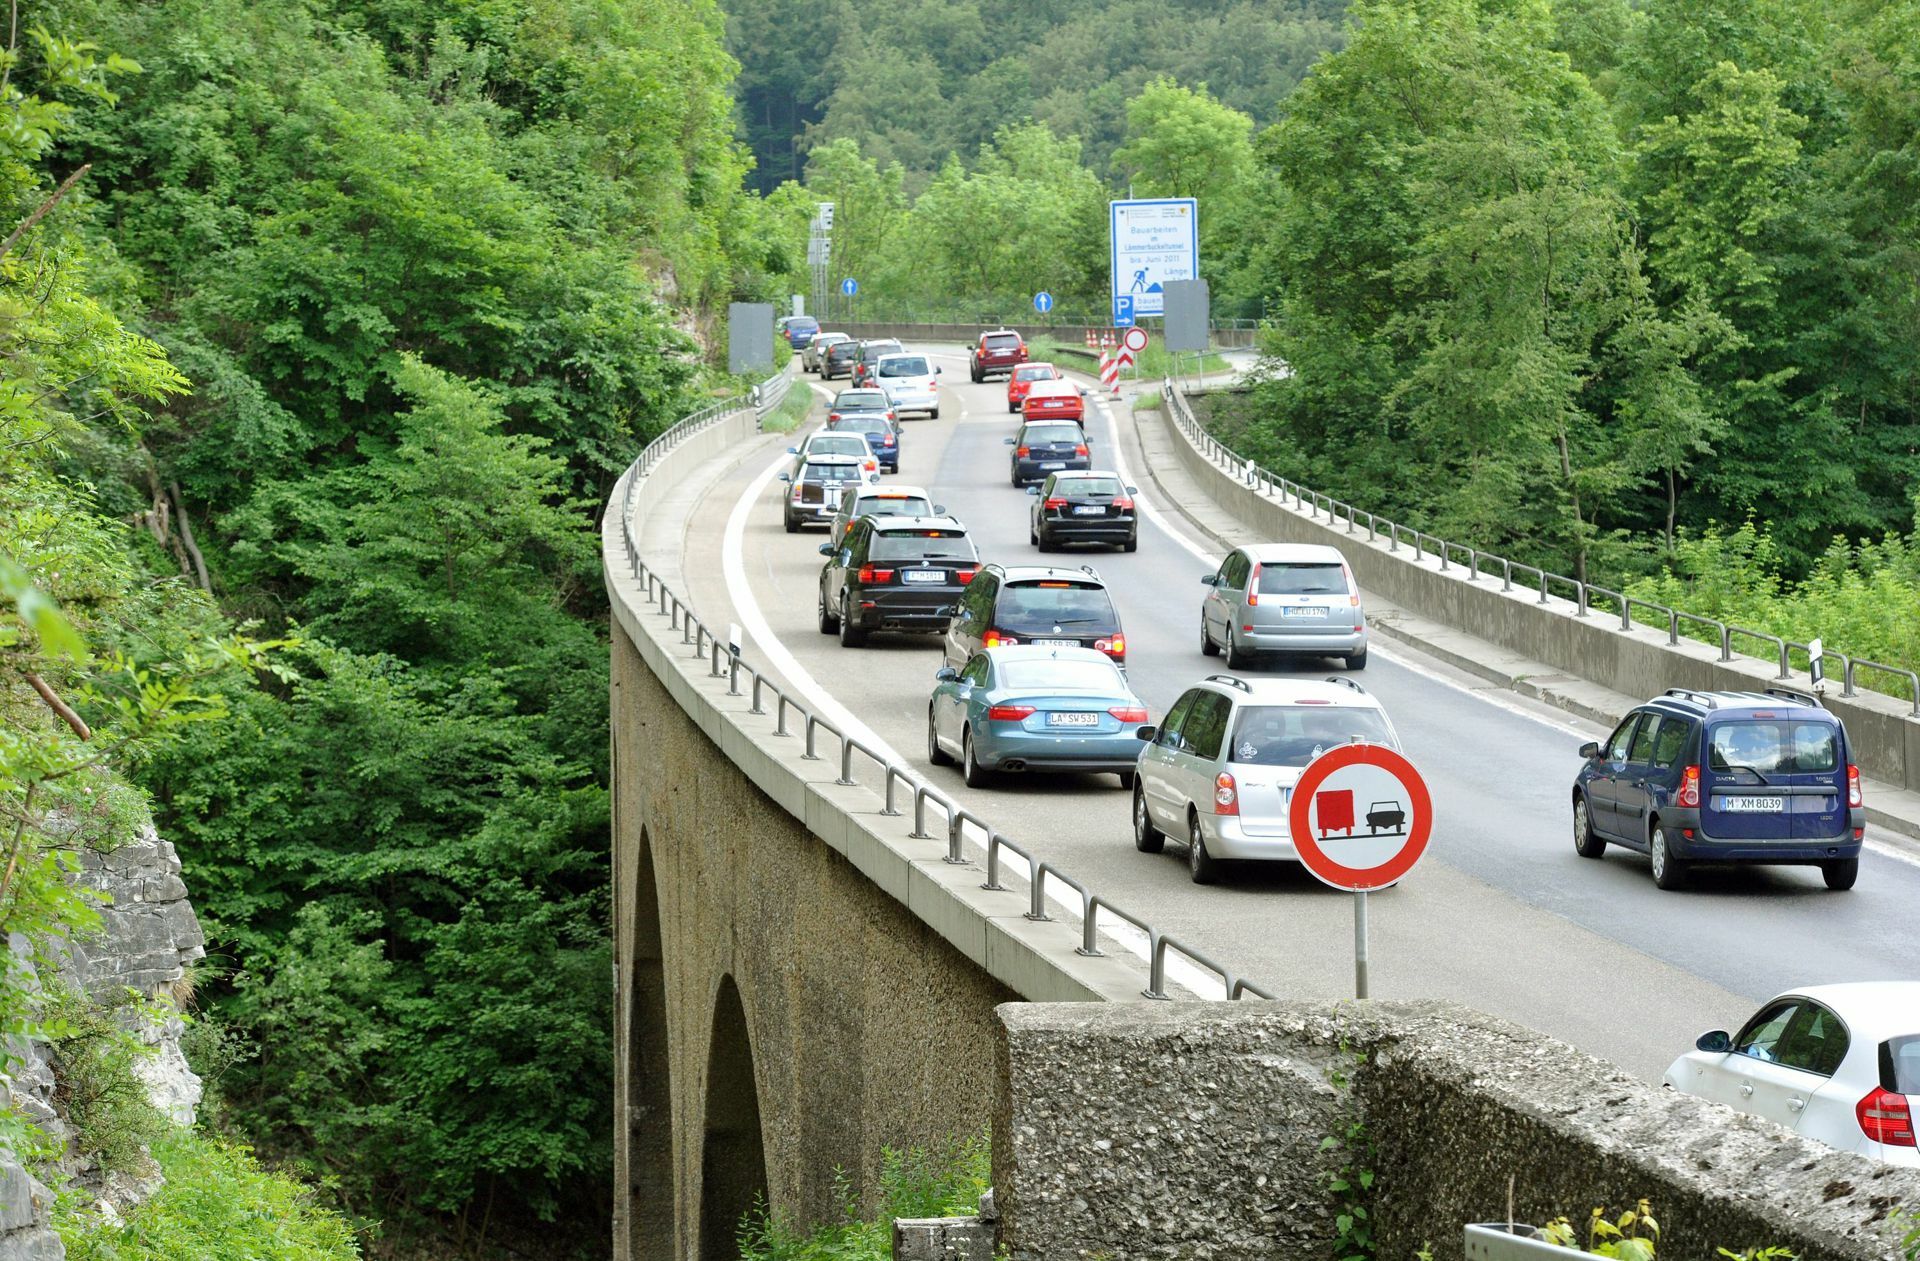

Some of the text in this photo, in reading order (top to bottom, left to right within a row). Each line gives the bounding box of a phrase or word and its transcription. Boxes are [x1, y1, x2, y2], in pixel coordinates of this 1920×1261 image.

[1130, 226, 1178, 234] Bauarbeiten
[1145, 255, 1162, 263] Juni
[1164, 254, 1180, 262] 2011
[1164, 267, 1188, 276] Länge
[1117, 298, 1130, 315] P
[1051, 714, 1097, 723] LA SW 531
[1727, 798, 1781, 809] M XM 8039
